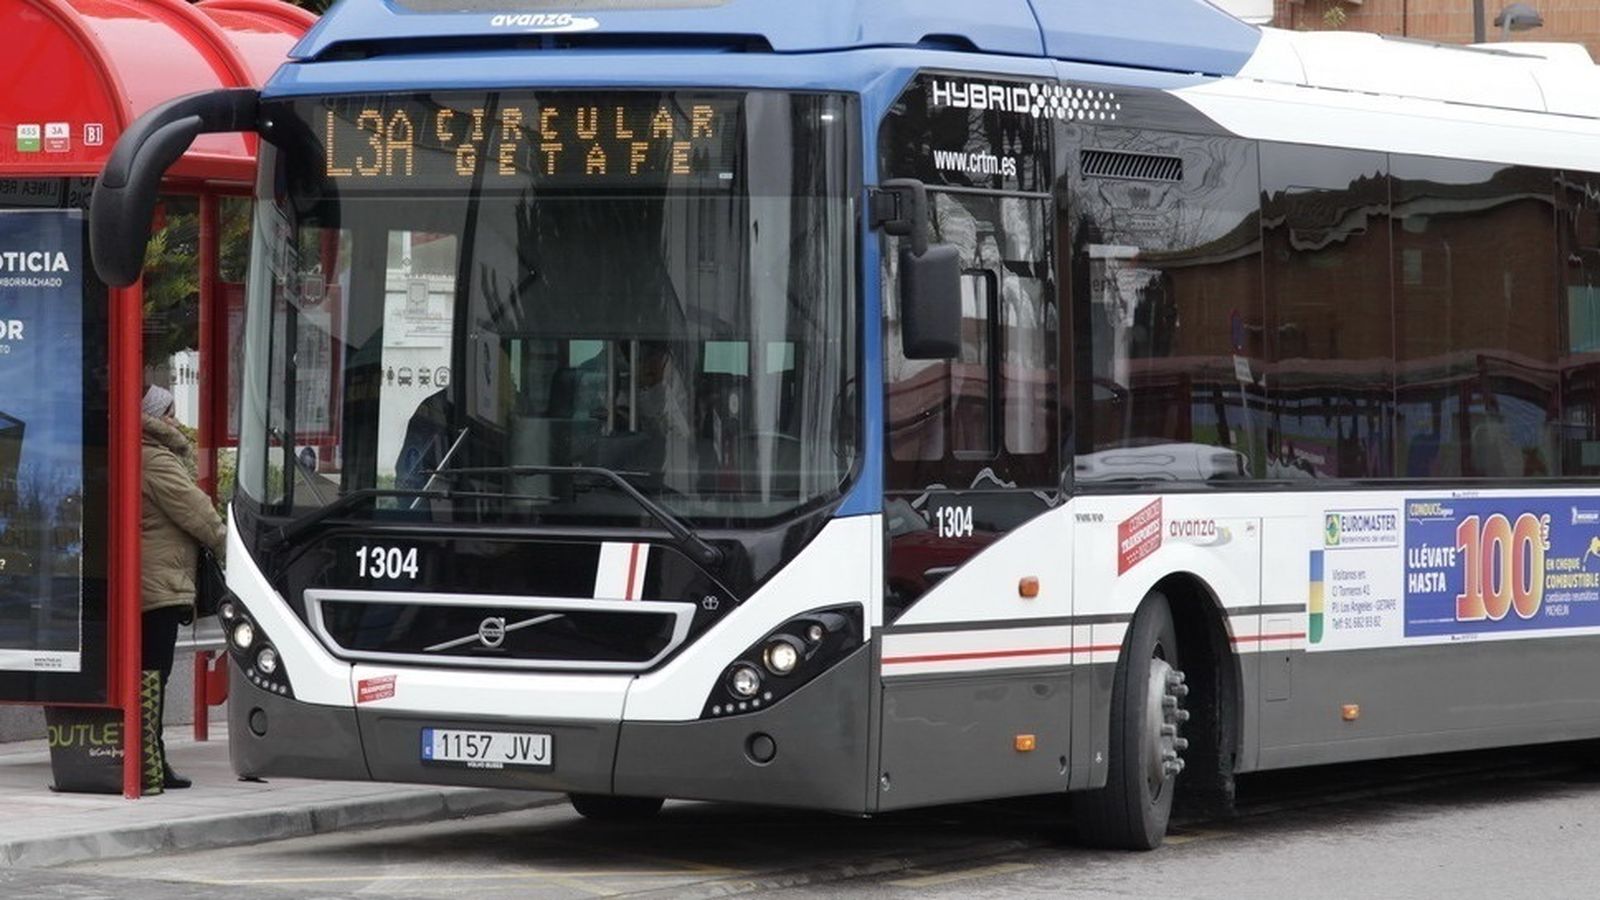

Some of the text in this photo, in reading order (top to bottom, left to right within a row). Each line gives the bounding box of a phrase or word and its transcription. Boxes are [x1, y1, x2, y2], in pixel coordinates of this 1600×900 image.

[491, 13, 572, 27] avanza
[933, 81, 1031, 113] HYBRID
[87, 126, 101, 143] B1
[437, 105, 713, 140] CIRCULAR
[326, 109, 413, 176] L3A
[455, 142, 692, 176] GETAFE
[934, 150, 1016, 176] www.crtm.es
[936, 506, 973, 538] 1304
[1170, 517, 1216, 537] avanza
[1341, 514, 1397, 532] EUROMASTER
[356, 546, 418, 580] 1304
[1409, 543, 1456, 568] LLÉVATE
[1408, 572, 1447, 594] HASTA
[1545, 572, 1600, 590] COMBUSTIBLE
[442, 733, 546, 761] 1157 JVJ
